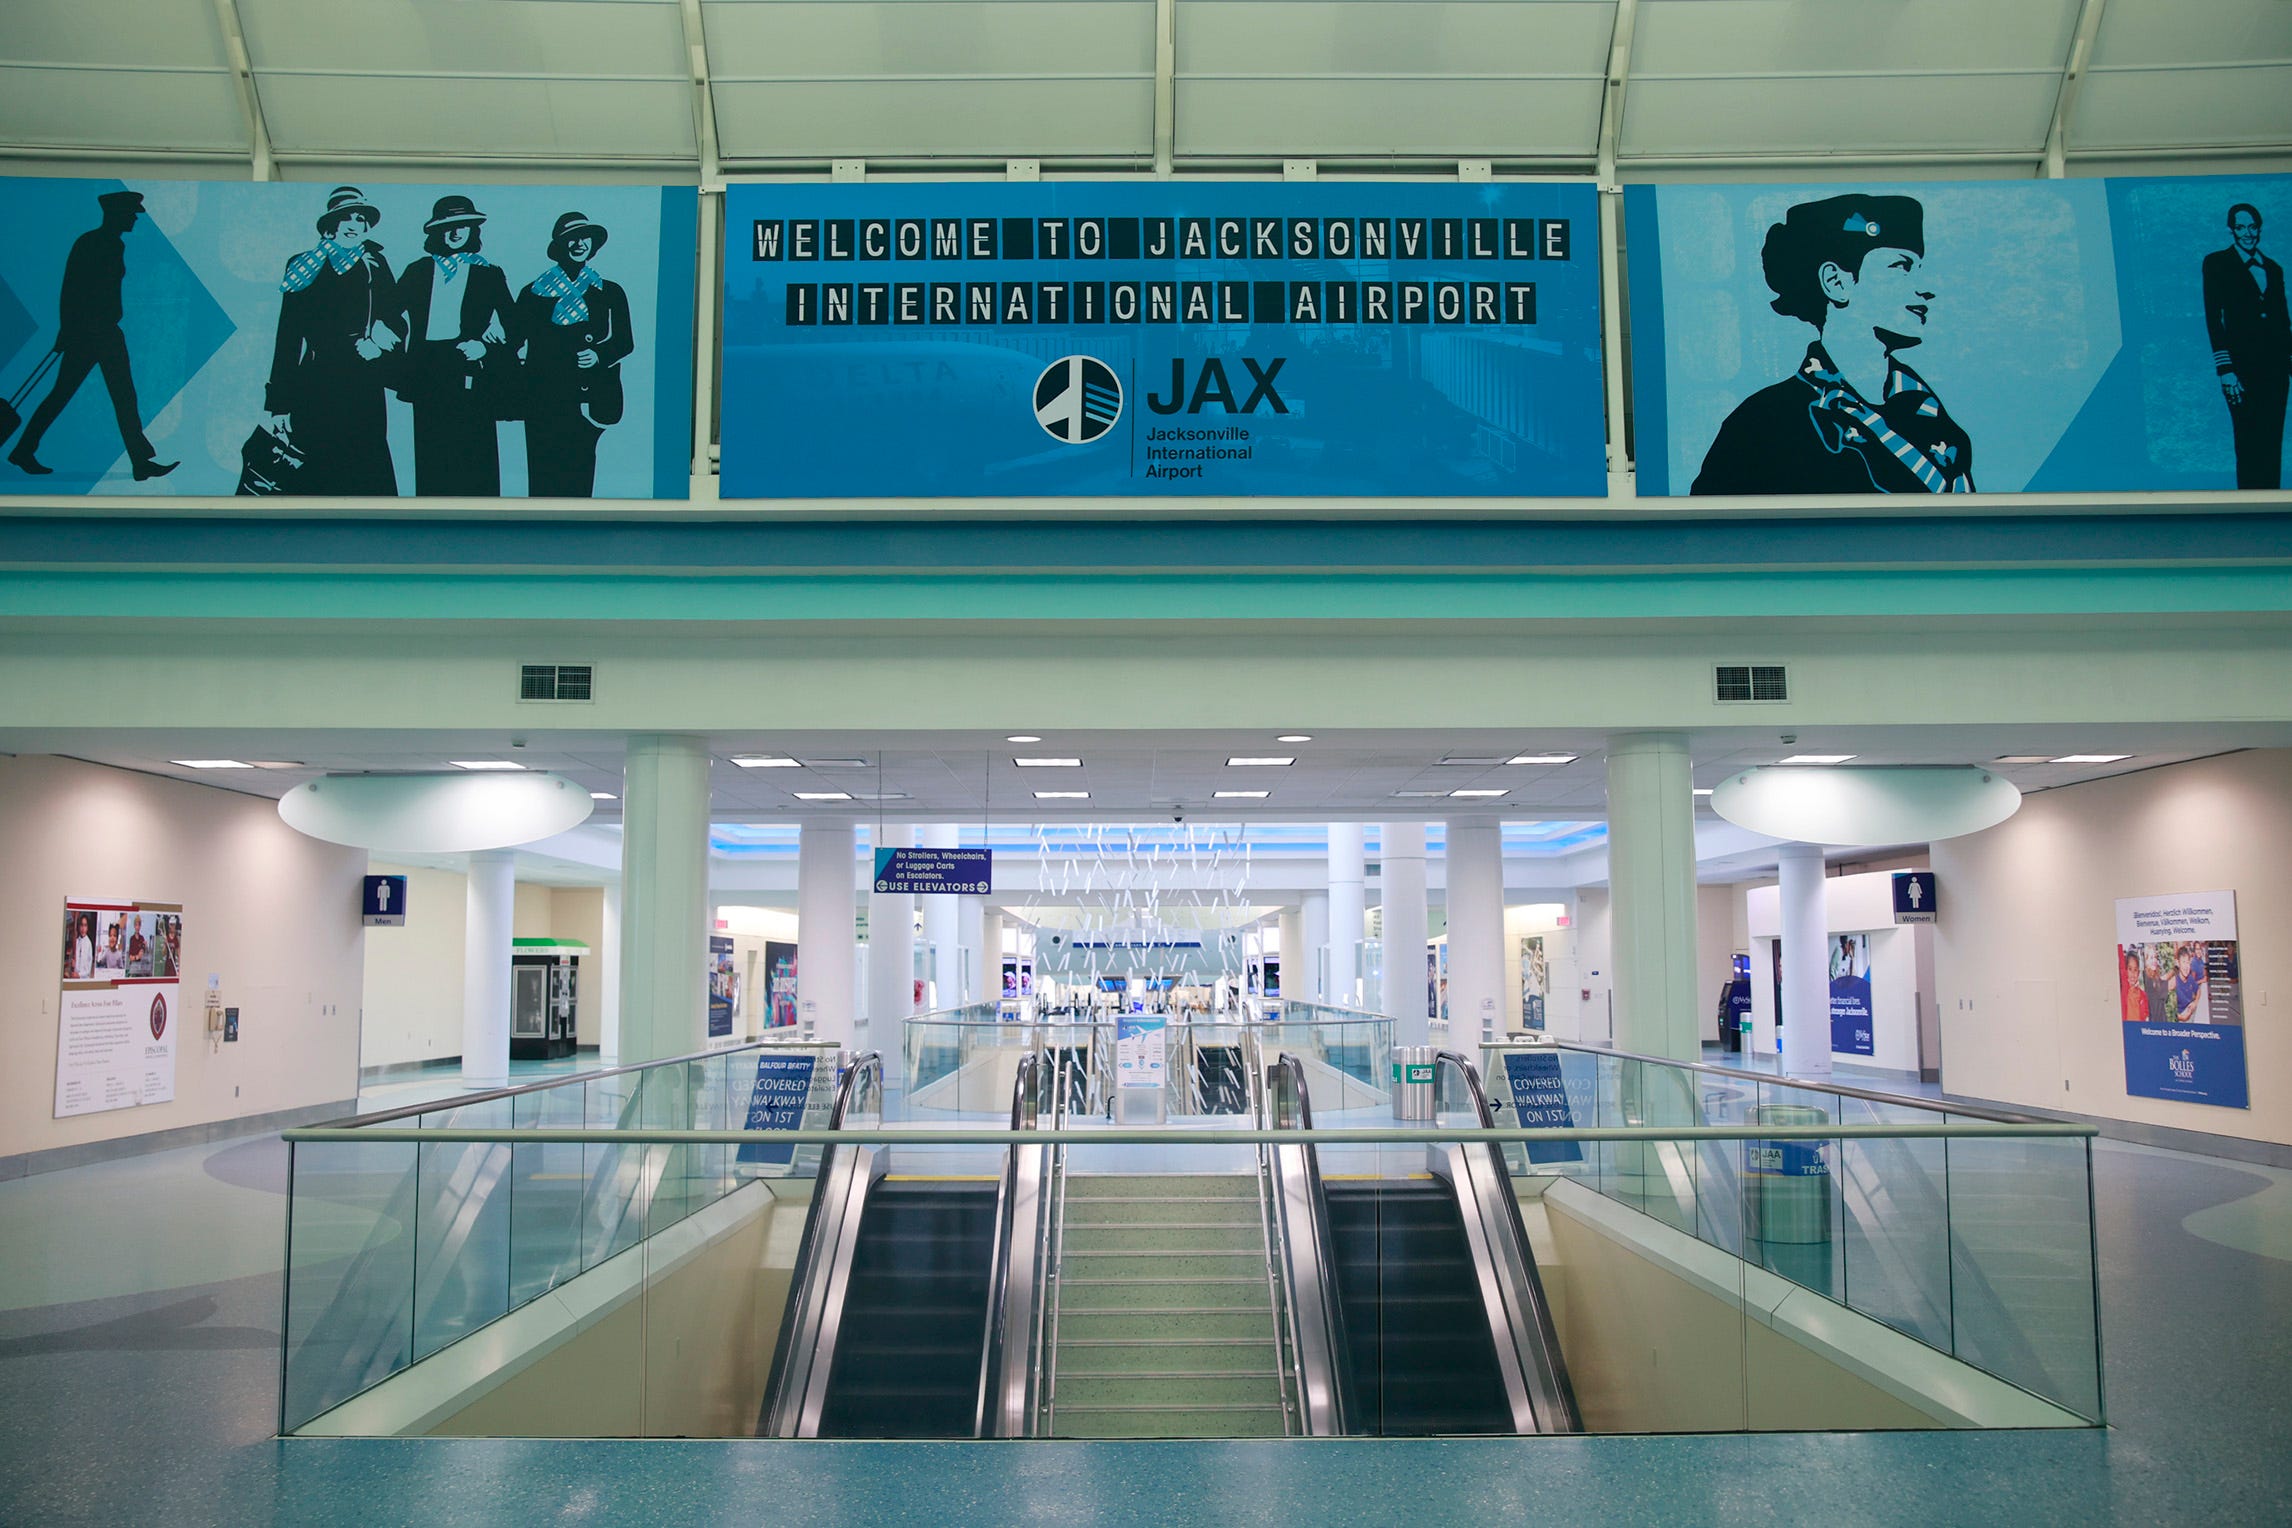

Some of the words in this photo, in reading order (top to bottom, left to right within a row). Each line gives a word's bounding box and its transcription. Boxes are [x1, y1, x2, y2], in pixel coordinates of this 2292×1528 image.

[756, 221, 992, 258] WELCOME
[1042, 221, 1101, 257] TO
[1149, 220, 1564, 257] JACKSONVILLE
[797, 285, 1243, 322] INTERNATIONAL
[1295, 285, 1532, 321] AIRPORT
[1146, 357, 1290, 416] JAX
[1146, 426, 1250, 442] Jacksonville
[1146, 445, 1253, 461] International
[1145, 464, 1203, 481] Airport
[896, 851, 906, 860] No
[907, 851, 940, 861] Strollers,
[941, 852, 987, 861] Wheelchairs,
[905, 862, 935, 871] Luggage
[936, 862, 955, 870] Carts
[895, 872, 905, 880] on
[906, 872, 945, 880] Escalators.
[888, 881, 909, 892] USE
[913, 882, 976, 893] ELEVATORS
[375, 917, 392, 925] Men
[1902, 915, 1931, 923] Women
[2140, 1027, 2162, 1037] Welcome
[2172, 1029, 2191, 1038] Broader
[2191, 1030, 2221, 1040] Perspective.
[144, 1044, 169, 1055] EPISCOPAL
[787, 1062, 811, 1070] BEATTY
[2169, 1057, 2195, 1072] BOLLES
[2174, 1070, 2193, 1079] SCHOOL
[757, 1079, 806, 1091] COVERED
[1513, 1078, 1561, 1091] COVERED
[752, 1096, 805, 1107] WALKWAY
[1515, 1093, 1564, 1107] WALKWAY
[755, 1110, 771, 1123] ON
[775, 1112, 794, 1123] 1ST
[1526, 1111, 1543, 1123] ON
[1546, 1109, 1563, 1122] 1ST
[1761, 1149, 1782, 1160] JAA
[1801, 1165, 1831, 1176] TRAS
